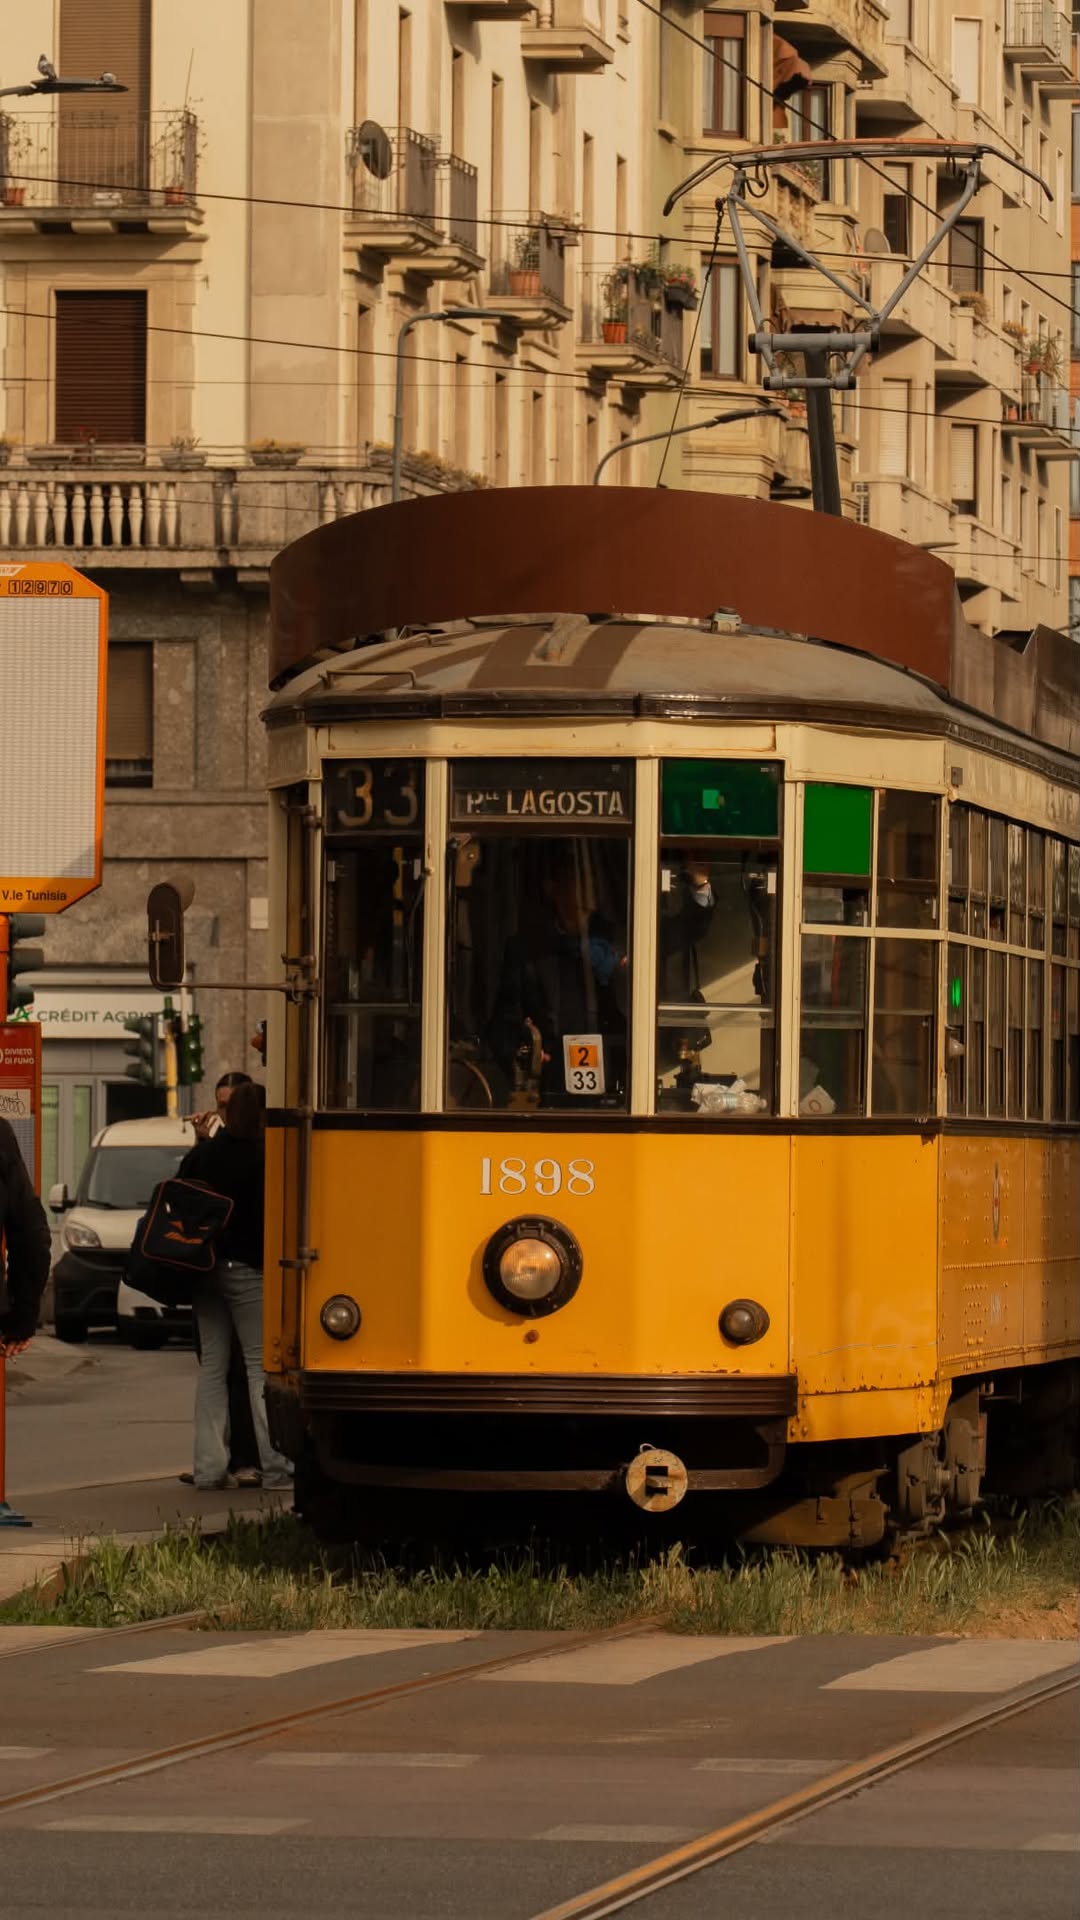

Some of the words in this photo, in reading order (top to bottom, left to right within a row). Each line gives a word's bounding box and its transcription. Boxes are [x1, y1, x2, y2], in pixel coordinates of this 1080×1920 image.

[10, 581, 72, 594] 12970
[336, 764, 418, 827] 33
[506, 789, 625, 815] LAGOSTA
[2, 889, 23, 901] V.le
[25, 889, 68, 901] Tunisia
[36, 1007, 100, 1023] CRÉDIT
[5, 1047, 33, 1055] DIVIETO
[578, 1047, 590, 1067] 2
[573, 1070, 598, 1090] 33
[479, 1156, 596, 1196] 1898
